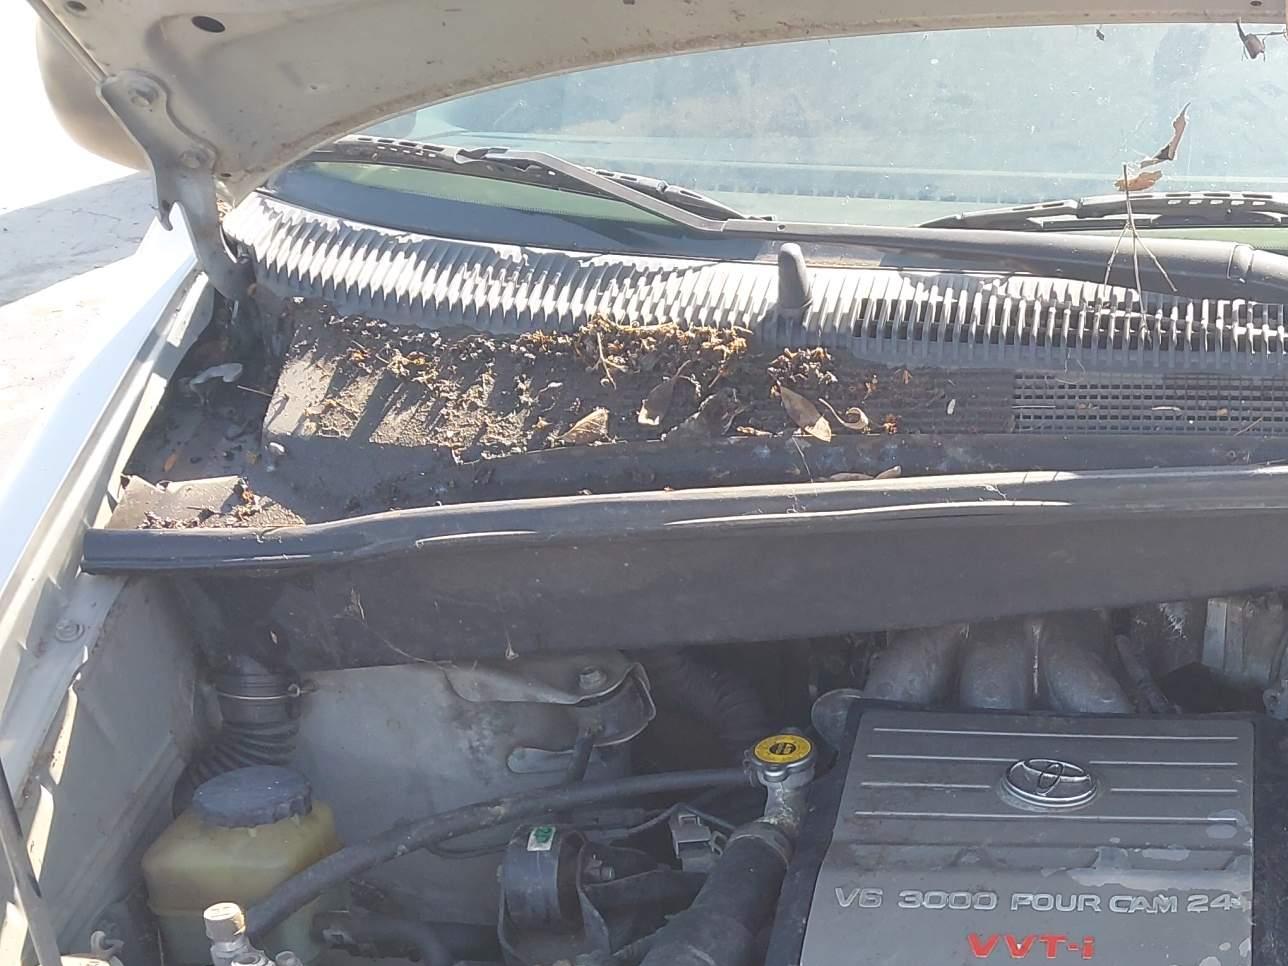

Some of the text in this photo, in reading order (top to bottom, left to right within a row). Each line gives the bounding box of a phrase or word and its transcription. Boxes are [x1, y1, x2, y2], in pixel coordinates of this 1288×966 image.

[834, 887, 884, 908] V6
[898, 890, 997, 911] 3000
[1109, 895, 1178, 913] CAM
[967, 933, 1096, 960] VVT-i
